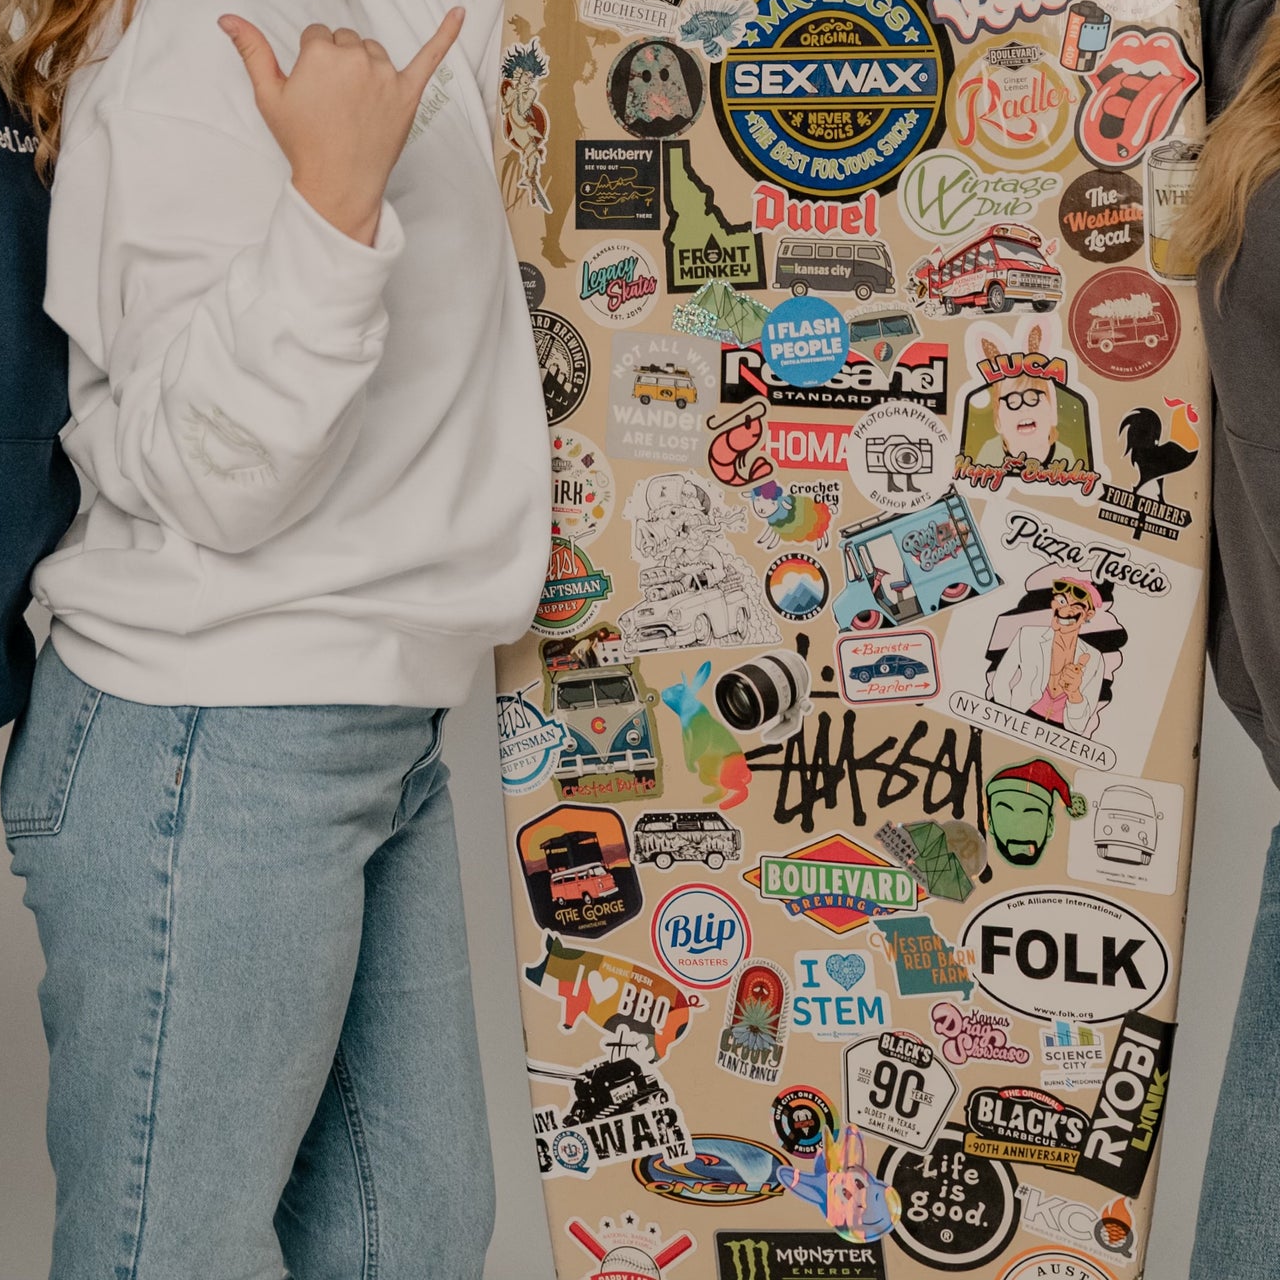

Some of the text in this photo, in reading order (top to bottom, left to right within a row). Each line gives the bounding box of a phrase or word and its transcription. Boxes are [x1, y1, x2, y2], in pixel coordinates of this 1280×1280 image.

[799, 30, 863, 47] ORIGINAL
[989, 46, 1039, 64] BOULEVARD
[733, 63, 819, 95] SEX
[1003, 76, 1028, 87] Ginger
[1003, 83, 1029, 93] Lemon
[807, 111, 850, 124] NEVER
[956, 70, 1078, 147] Radler
[807, 124, 854, 141] SPOILS
[584, 147, 654, 163] Huckberry
[769, 116, 916, 181] BEST FOR YOUR STICK
[973, 196, 1034, 217] Dub
[1085, 186, 1121, 208] The
[635, 212, 653, 220] THERE
[753, 184, 878, 238] Duvel
[1084, 224, 1132, 253] Local
[592, 244, 631, 263] KANSAS CITY
[579, 256, 640, 300] Legacy
[679, 263, 752, 280] MONKEY
[793, 262, 852, 279] kansas city
[606, 275, 658, 313] Skates
[767, 317, 841, 340] I FLASH
[553, 321, 586, 368] BREWING
[770, 337, 843, 361] PEOPLE
[612, 345, 642, 380] NOT
[648, 338, 680, 355] ALL
[686, 349, 717, 389] WHO
[976, 351, 1068, 386] LUCA
[772, 390, 872, 405] STANDARD
[854, 405, 949, 445] PHOTOGRAPHIQUE
[622, 431, 699, 452] ARE LOST
[952, 454, 1101, 496] Happy Birthday
[789, 481, 841, 497] Crochet
[813, 493, 840, 505] City
[869, 490, 933, 510] BISHOP ARTS
[1105, 487, 1188, 526] FOUR CORNERS
[1100, 510, 1179, 540] BREWING DALLAS TX
[1006, 514, 1168, 593] Pizza Tascio
[537, 601, 578, 615] SUPPLY
[861, 642, 910, 656] Barista
[867, 681, 914, 695] Parlor
[955, 696, 1108, 767] NY STYLE PIZZERIA
[616, 777, 657, 793] Butte
[767, 863, 914, 903] BOULEVARD
[790, 895, 867, 914] BREWING
[1007, 897, 1123, 920] Folk Alliance International
[664, 912, 736, 954] Blip
[677, 957, 729, 967] ROASTERS
[903, 948, 977, 970] RED BARN
[981, 924, 1148, 991] FOLK
[630, 972, 654, 988] FRESH
[800, 959, 821, 989] I
[931, 968, 970, 986] FARM
[617, 981, 671, 1035] BBQ
[792, 995, 885, 1026] STEM
[970, 1008, 1011, 1030] Kansas
[1033, 1005, 1095, 1020] www.folk.org
[880, 1033, 934, 1065] BLACK'S
[1045, 1049, 1104, 1062] SCIENCE
[717, 1048, 780, 1083] PLANTS RANCH
[1062, 1060, 1088, 1070] CITY
[868, 1059, 926, 1120] 90
[1043, 1079, 1065, 1087] BURNS
[774, 1091, 829, 1121] ONE ONE TEAM
[910, 1089, 934, 1105] YEARS
[1021, 1089, 1060, 1109] ORIGINAL
[1083, 1027, 1162, 1168] RYOBI
[863, 1106, 918, 1132] OLDEST TEXAS
[867, 1119, 911, 1138] SAME FAMILY
[976, 1096, 1083, 1144] BLACK'S
[585, 1107, 686, 1161] WAR
[996, 1126, 1057, 1149] BARBECUE
[665, 1141, 689, 1160] NZ
[793, 1143, 816, 1154] PRIDE
[972, 1141, 1080, 1166] 90TH ANNIVERSARY
[920, 1151, 980, 1186] Life
[644, 1179, 785, 1197] O'NEILL
[939, 1179, 966, 1202] is
[791, 1267, 863, 1275] ENERGY
